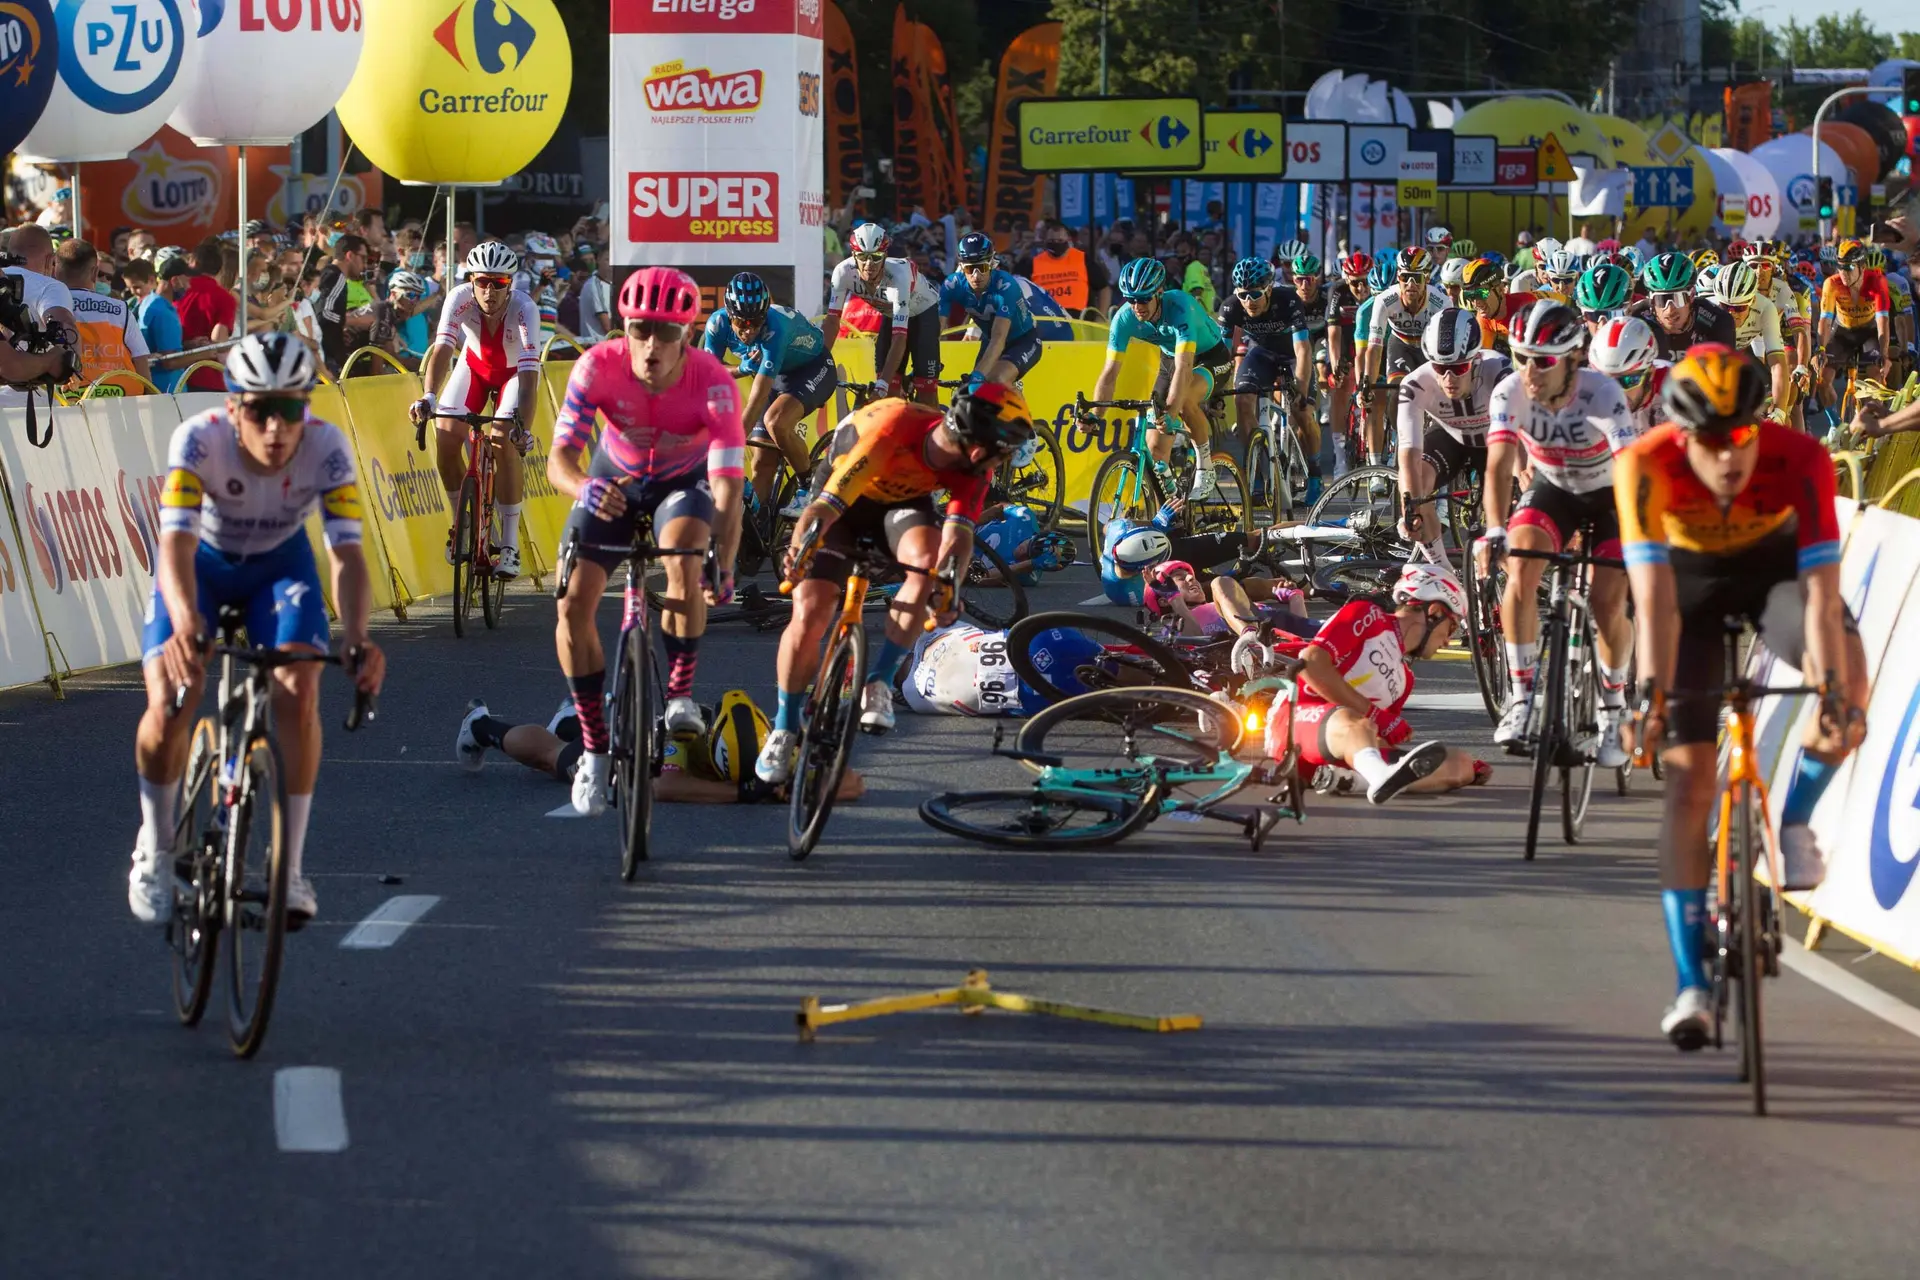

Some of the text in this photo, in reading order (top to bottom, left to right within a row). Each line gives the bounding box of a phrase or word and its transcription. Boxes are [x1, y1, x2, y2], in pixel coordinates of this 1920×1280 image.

[86, 5, 164, 71] PZU
[655, 63, 683, 74] RADIO
[419, 88, 549, 114] Carrefour
[646, 73, 758, 108] wawa
[651, 116, 756, 124] NAJLEPSZE POLSKIE HITY
[1029, 126, 1132, 146] Carrefour
[1411, 162, 1435, 170] LOTOS
[151, 176, 208, 208] LOTTO
[633, 177, 774, 218] SUPER
[1403, 186, 1432, 199] 50m
[690, 219, 774, 239] express
[73, 297, 122, 315] Pologne
[927, 360, 937, 378] UAE
[796, 422, 808, 438] 23
[1531, 418, 1589, 443] UAE
[372, 450, 445, 522] Carrefour
[44, 487, 123, 582] LOTOS
[980, 640, 1007, 667] 96
[980, 681, 1008, 704] 96
